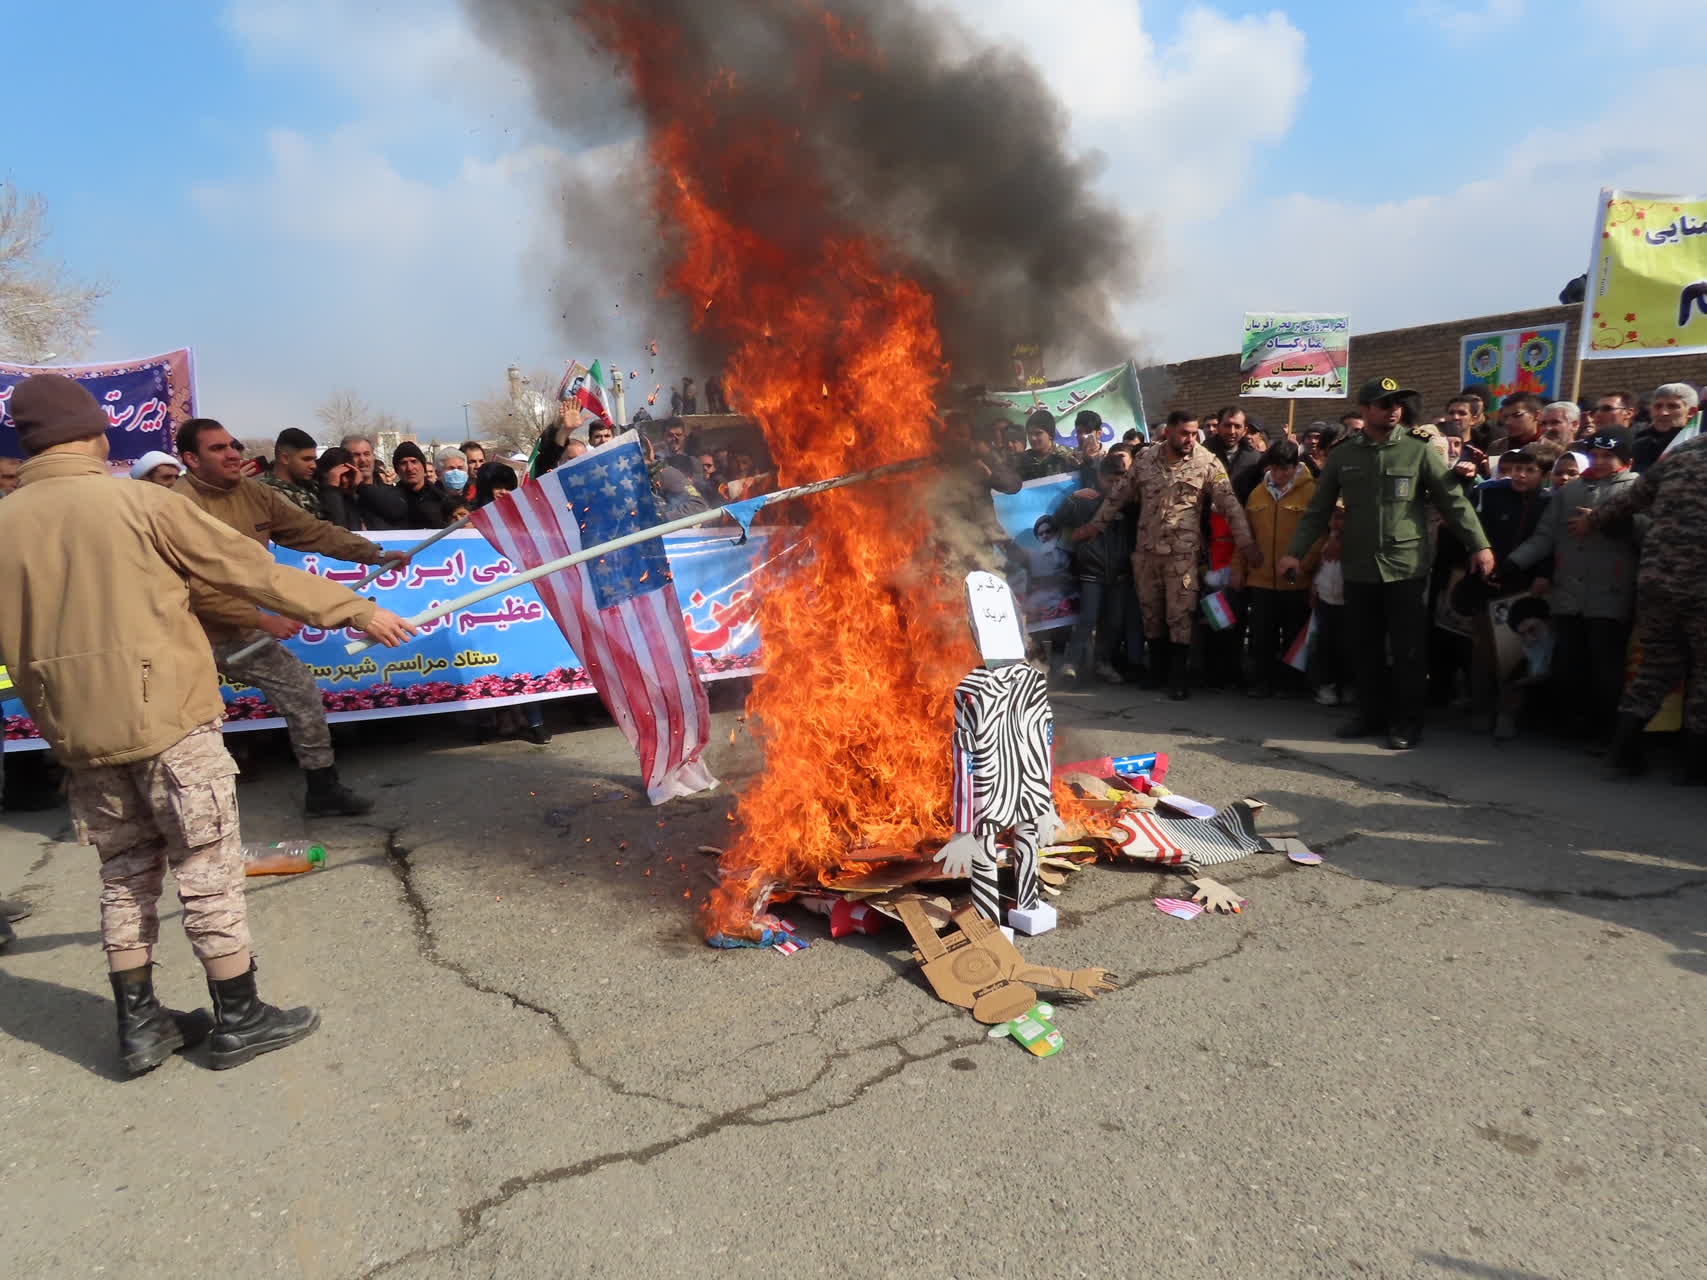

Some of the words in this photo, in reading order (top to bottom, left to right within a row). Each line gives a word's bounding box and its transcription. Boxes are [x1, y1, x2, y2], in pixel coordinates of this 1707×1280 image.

[459, 597, 543, 634] عظیم
[383, 654, 448, 682] مراسم
[453, 650, 499, 668] ستاد
